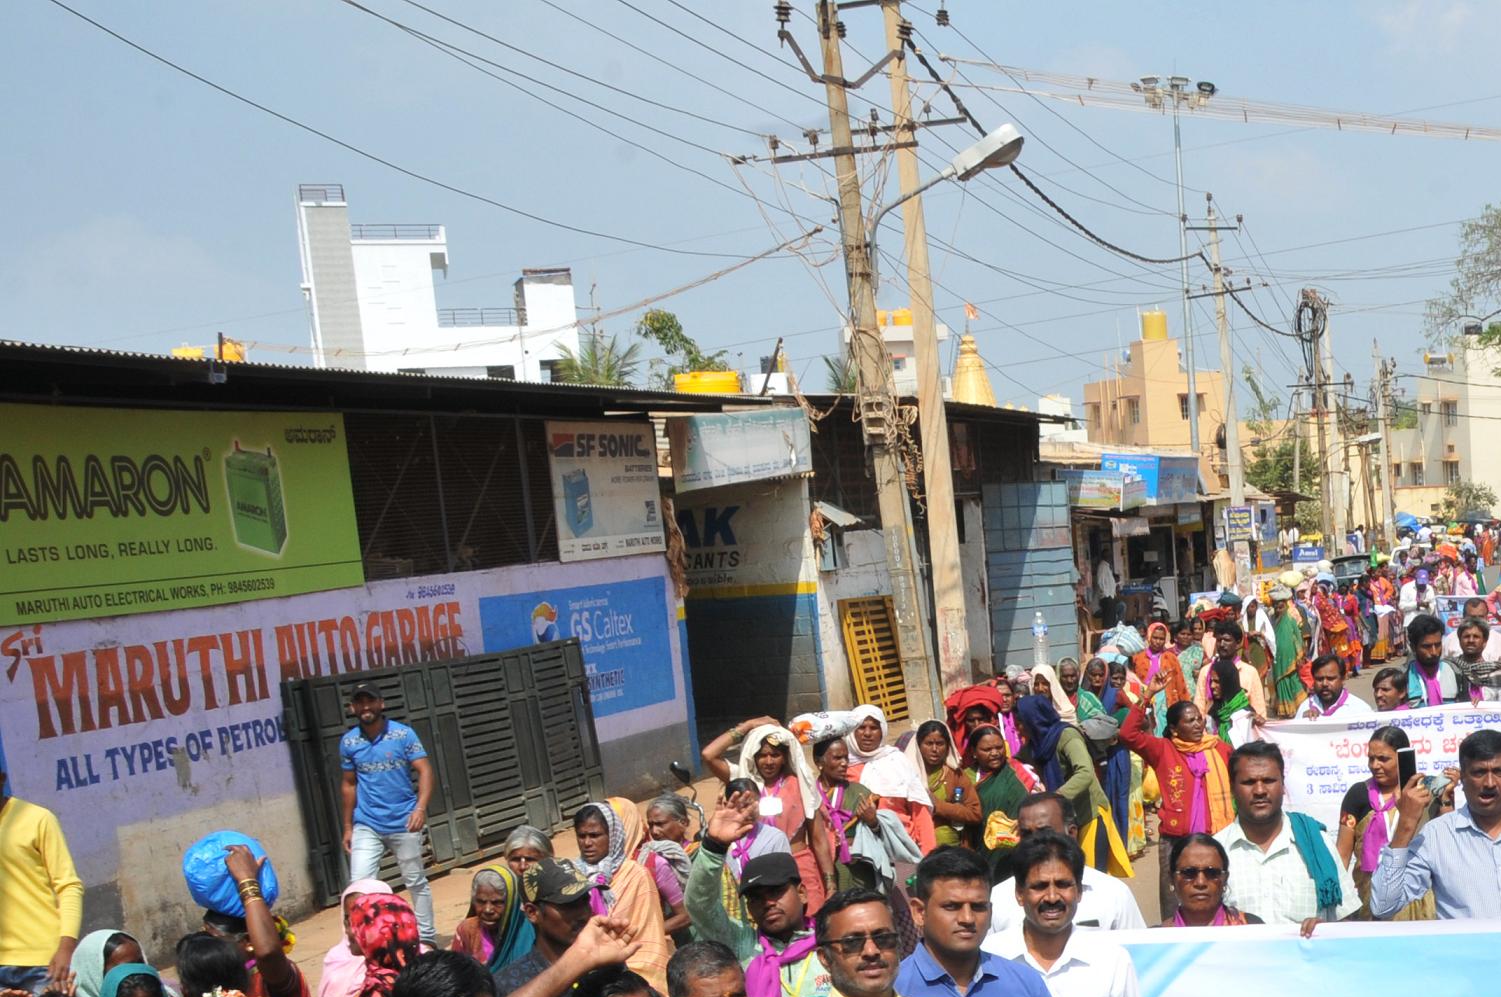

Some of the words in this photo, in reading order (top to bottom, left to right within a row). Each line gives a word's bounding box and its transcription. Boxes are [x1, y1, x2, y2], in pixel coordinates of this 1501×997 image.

[576, 433, 595, 458] SF
[598, 433, 650, 458] SONIC
[0, 453, 211, 522] AMARON
[6, 544, 60, 565] LASTS
[66, 544, 114, 562] LONG,
[119, 538, 170, 558] REALLY
[176, 536, 218, 554] LONG.
[16, 596, 71, 616] MARUTHI
[72, 594, 103, 611] AUTO
[105, 587, 168, 607] ELECTRICAL
[210, 582, 227, 598] PH:
[228, 577, 275, 595] 9845602539
[570, 610, 592, 642] GS
[593, 608, 634, 640] Caltex
[1, 625, 44, 684] Sri
[23, 628, 270, 741] MARUTHI
[275, 615, 363, 682] AUTO
[365, 601, 467, 668] GARAGE
[56, 753, 101, 791] ALL
[104, 735, 189, 781] TYPES
[186, 731, 214, 762] OF
